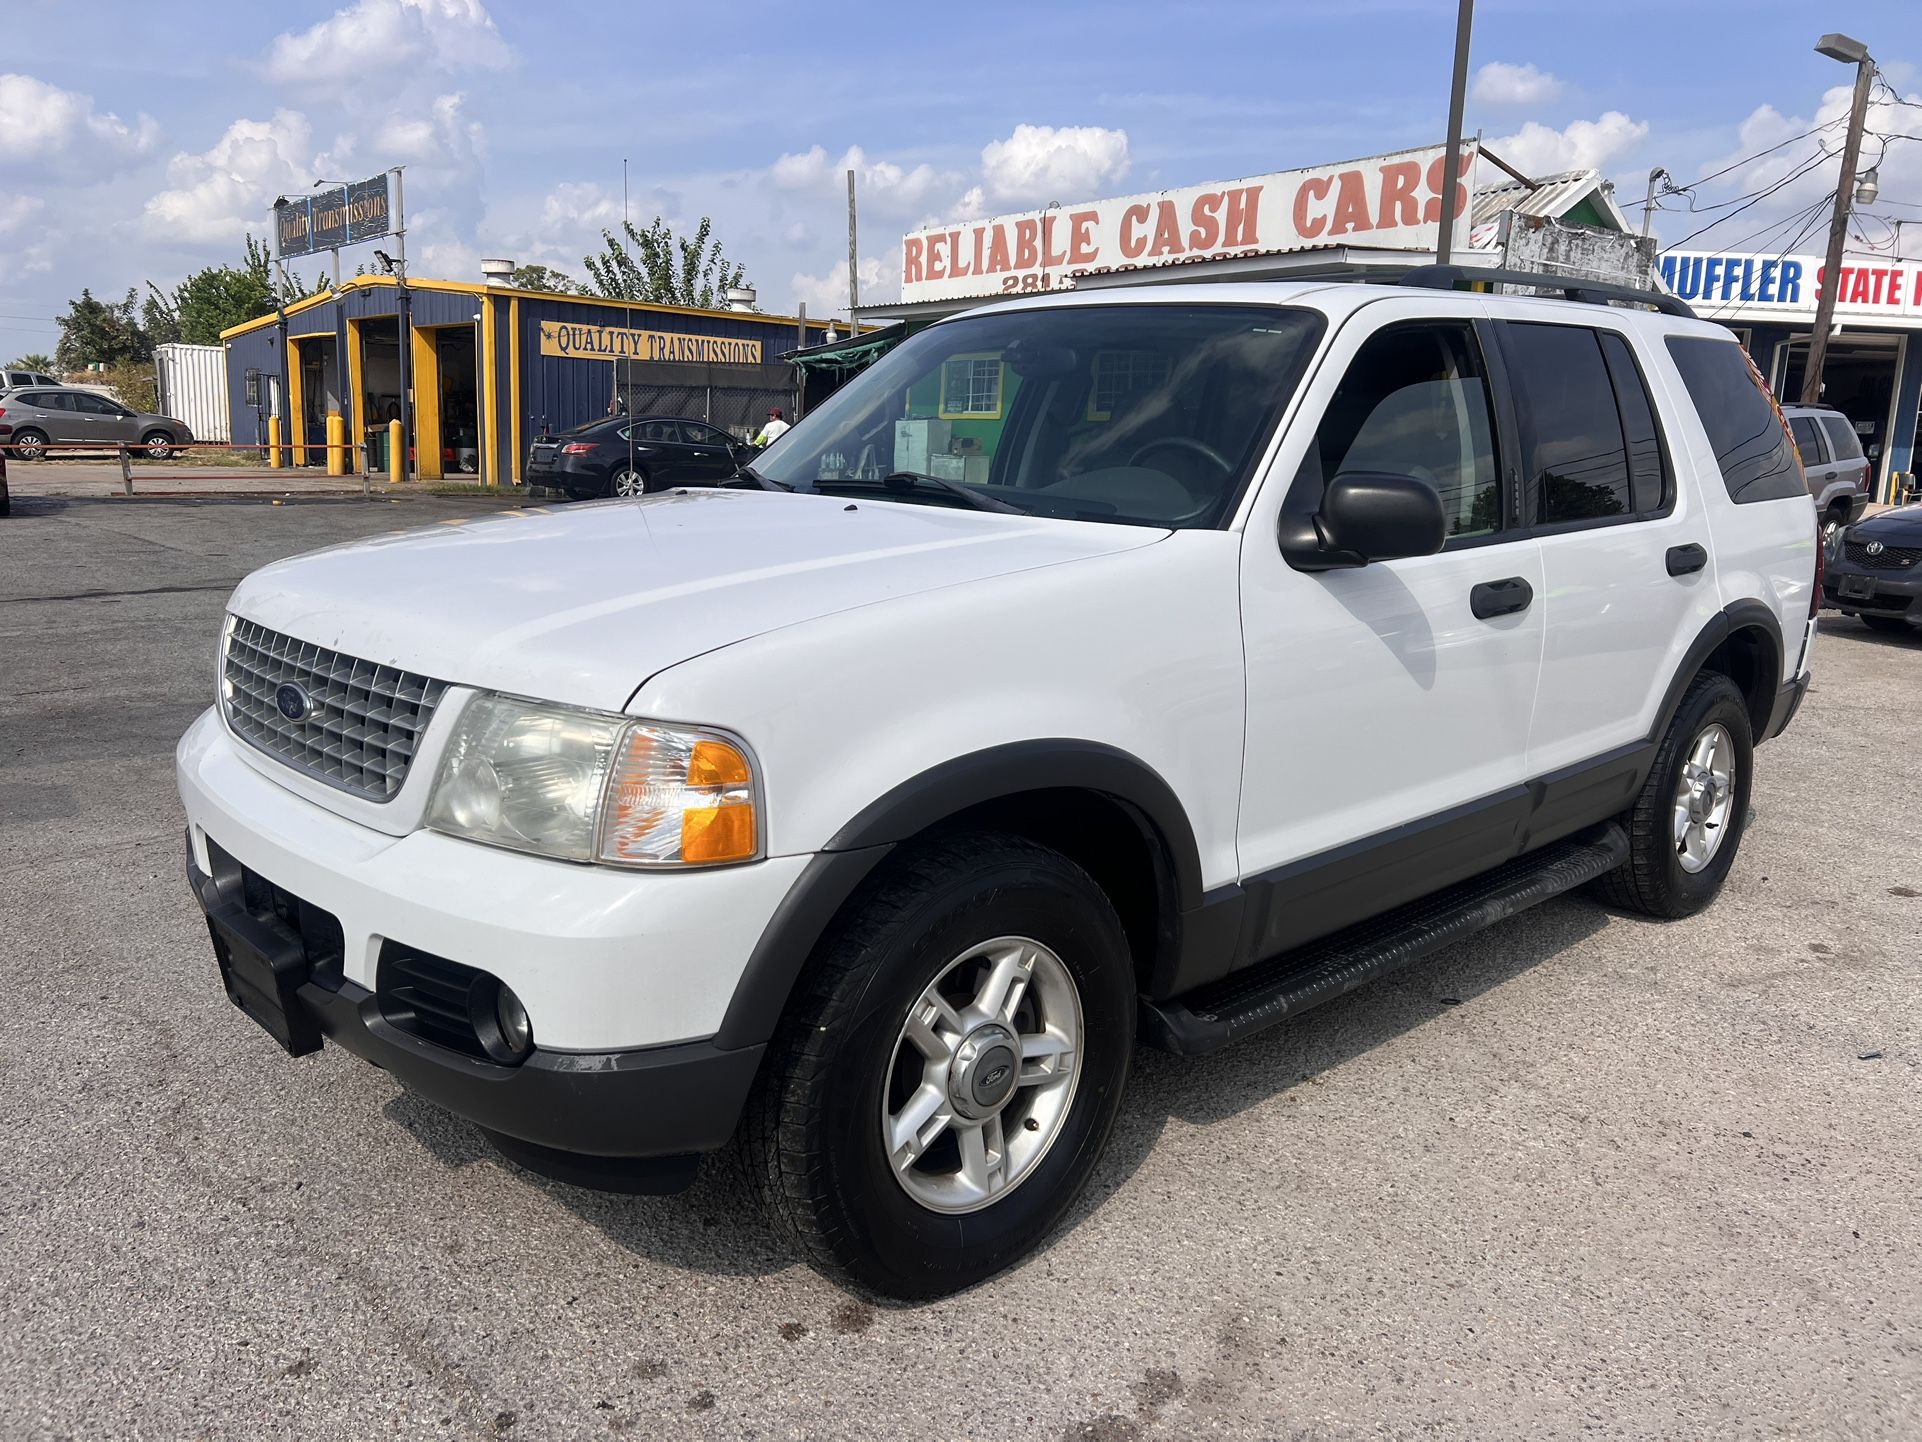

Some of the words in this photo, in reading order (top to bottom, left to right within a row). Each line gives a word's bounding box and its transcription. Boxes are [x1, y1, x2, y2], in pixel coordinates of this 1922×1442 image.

[281, 212, 310, 243] Quality
[312, 193, 386, 233] Transmissions
[904, 210, 1100, 283] RELIABLE
[1119, 185, 1264, 258] CASH
[1293, 151, 1475, 240] CARS
[1654, 255, 1803, 303] MUFFLER
[557, 325, 642, 355] QUALITY
[647, 334, 757, 364] TRANSMISSIONS
